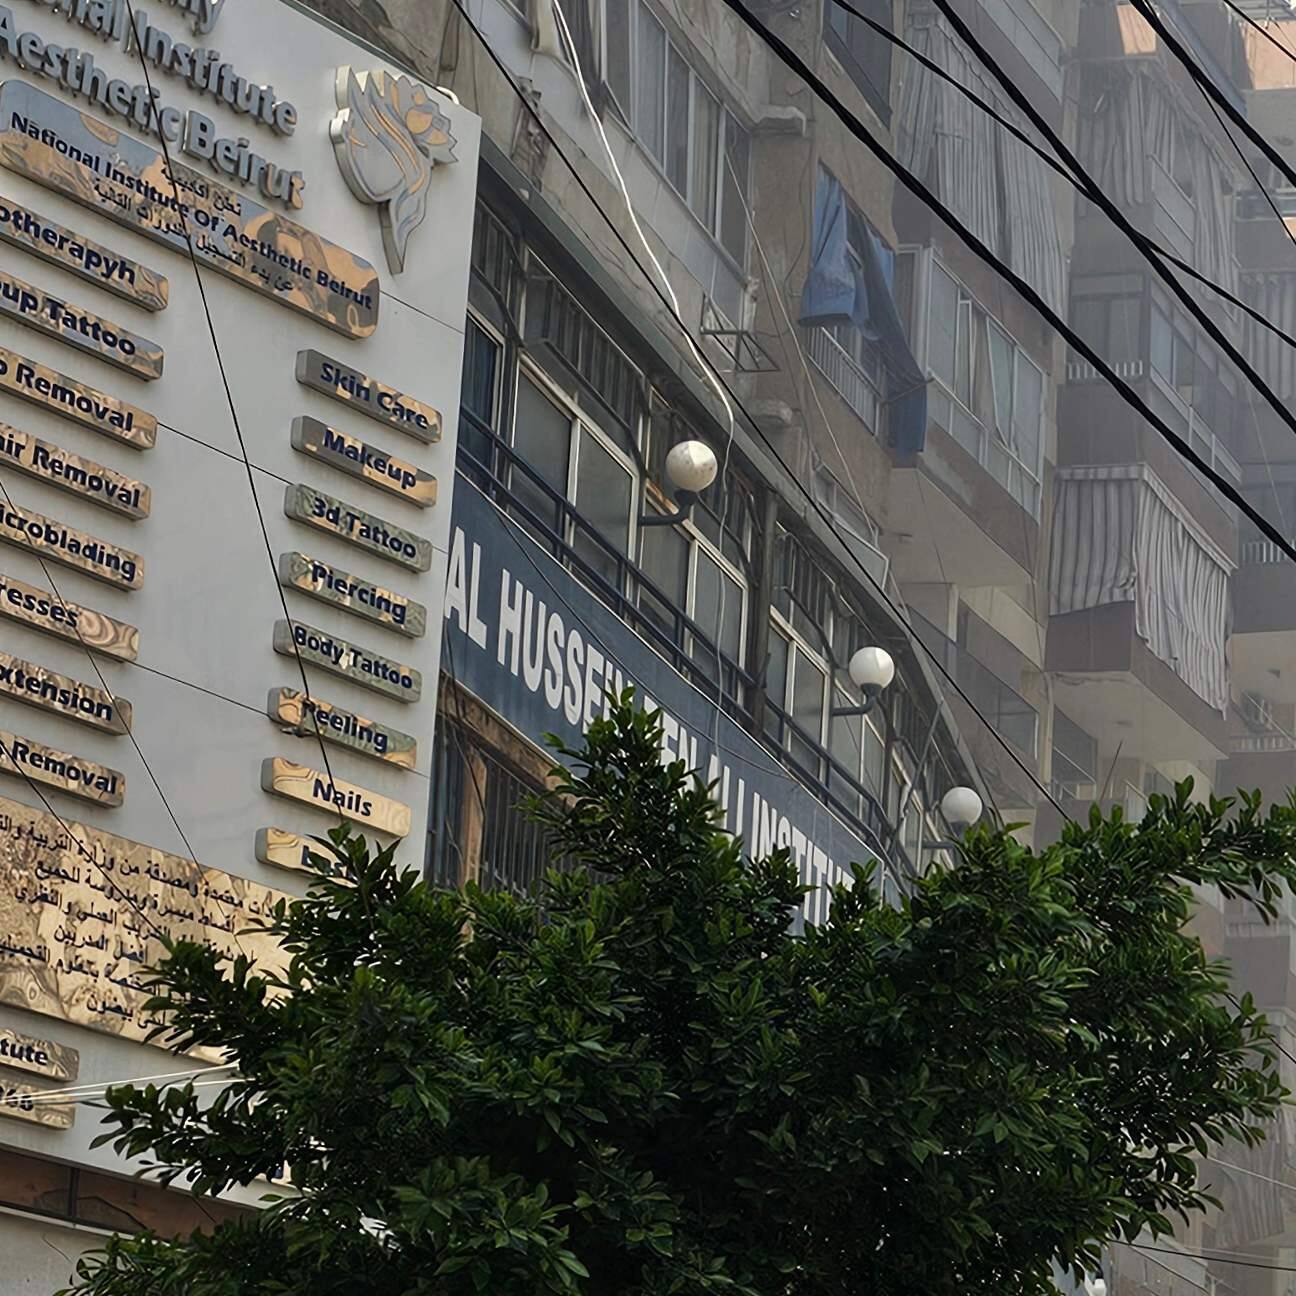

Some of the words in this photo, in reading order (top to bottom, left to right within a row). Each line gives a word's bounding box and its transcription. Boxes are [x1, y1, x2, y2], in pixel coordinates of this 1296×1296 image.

[124, 8, 298, 137] Institute
[0, 5, 181, 142] Aesthetic
[183, 110, 306, 210] Beirut
[11, 112, 99, 173] National
[106, 165, 190, 219] Institute
[194, 209, 221, 233] Of
[223, 223, 312, 282] Aesthetic
[315, 269, 373, 311] Beirut
[45, 296, 137, 356] Tattoo
[16, 362, 134, 433] Removal
[320, 361, 371, 402] Skin
[376, 391, 429, 430] Care
[32, 444, 141, 509] Removal
[323, 428, 417, 490] Makeup
[311, 496, 340, 528] 3d
[345, 511, 417, 560] Tattoo
[311, 563, 407, 626] Piercing
[445, 526, 488, 650] AL
[294, 625, 345, 666] Body
[350, 649, 414, 690] Tattoo
[302, 700, 389, 754] Peeling
[11, 740, 117, 795] Removal
[312, 777, 373, 818] Nails
[35, 860, 80, 885] للجميع
[120, 858, 140, 876] من
